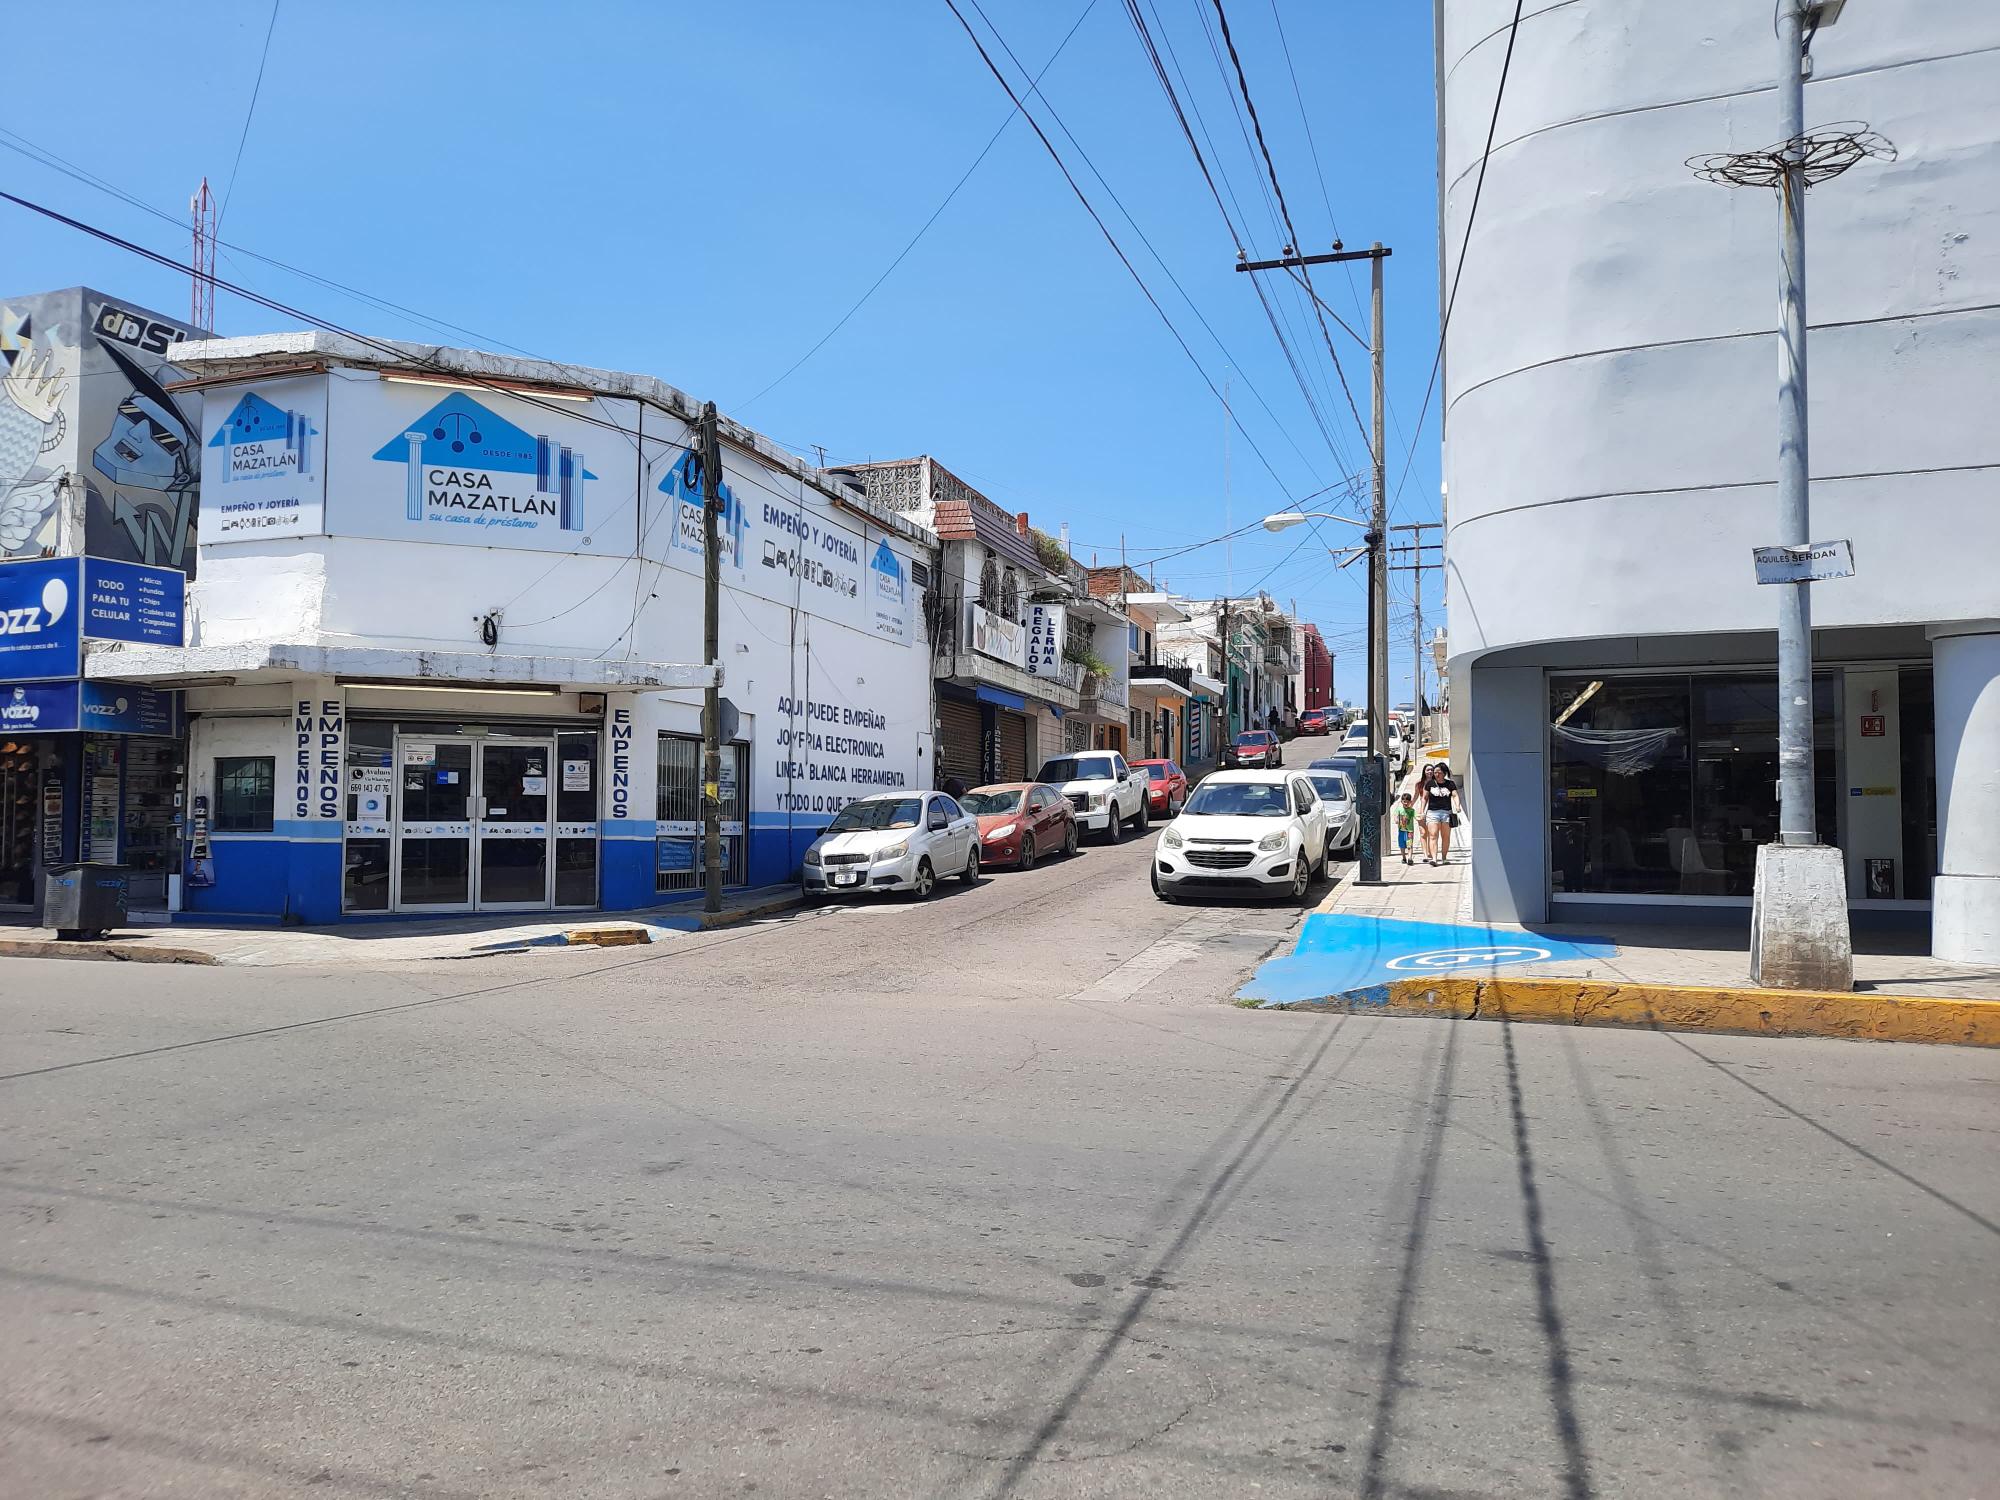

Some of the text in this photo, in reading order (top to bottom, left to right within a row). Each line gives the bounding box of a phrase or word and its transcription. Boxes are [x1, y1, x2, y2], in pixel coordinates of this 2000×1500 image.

[232, 452, 297, 471] MAZATLÁN
[233, 444, 265, 458] CASA
[482, 449, 512, 458] DESDE
[429, 469, 493, 490] CASA
[220, 496, 300, 513] EMPEÑO Y JOYERÍA
[428, 490, 556, 516] MAZATLÁN
[428, 512, 538, 530] su casa de préstamo
[681, 504, 705, 526] CAS
[763, 503, 858, 565] EMPEÑO Y JOYERÍA
[1757, 549, 1837, 565] AQUILES SERDAN
[97, 579, 124, 591] TODO
[92, 593, 130, 606] PARA TU
[143, 597, 160, 606] Chips
[91, 608, 131, 621] CELULAR
[142, 608, 164, 617] Cables
[1028, 607, 1043, 674] REGALOS
[1042, 617, 1055, 665] LERMA
[82, 703, 116, 716] VOZZ
[777, 696, 886, 731] AQUI PUEDE EMPEÑAR
[825, 735, 885, 759] ELECTRONICA
[296, 701, 313, 818] EMPEÑOS
[319, 701, 343, 818] EMPEÑOS
[612, 709, 632, 819] EMPEÑOS
[776, 760, 905, 788] LINEA BLANCA HERRAMIENTA
[776, 792, 783, 811] Y
[784, 791, 810, 812] TODO
[812, 795, 824, 813] LO
[826, 796, 842, 814] QUE
